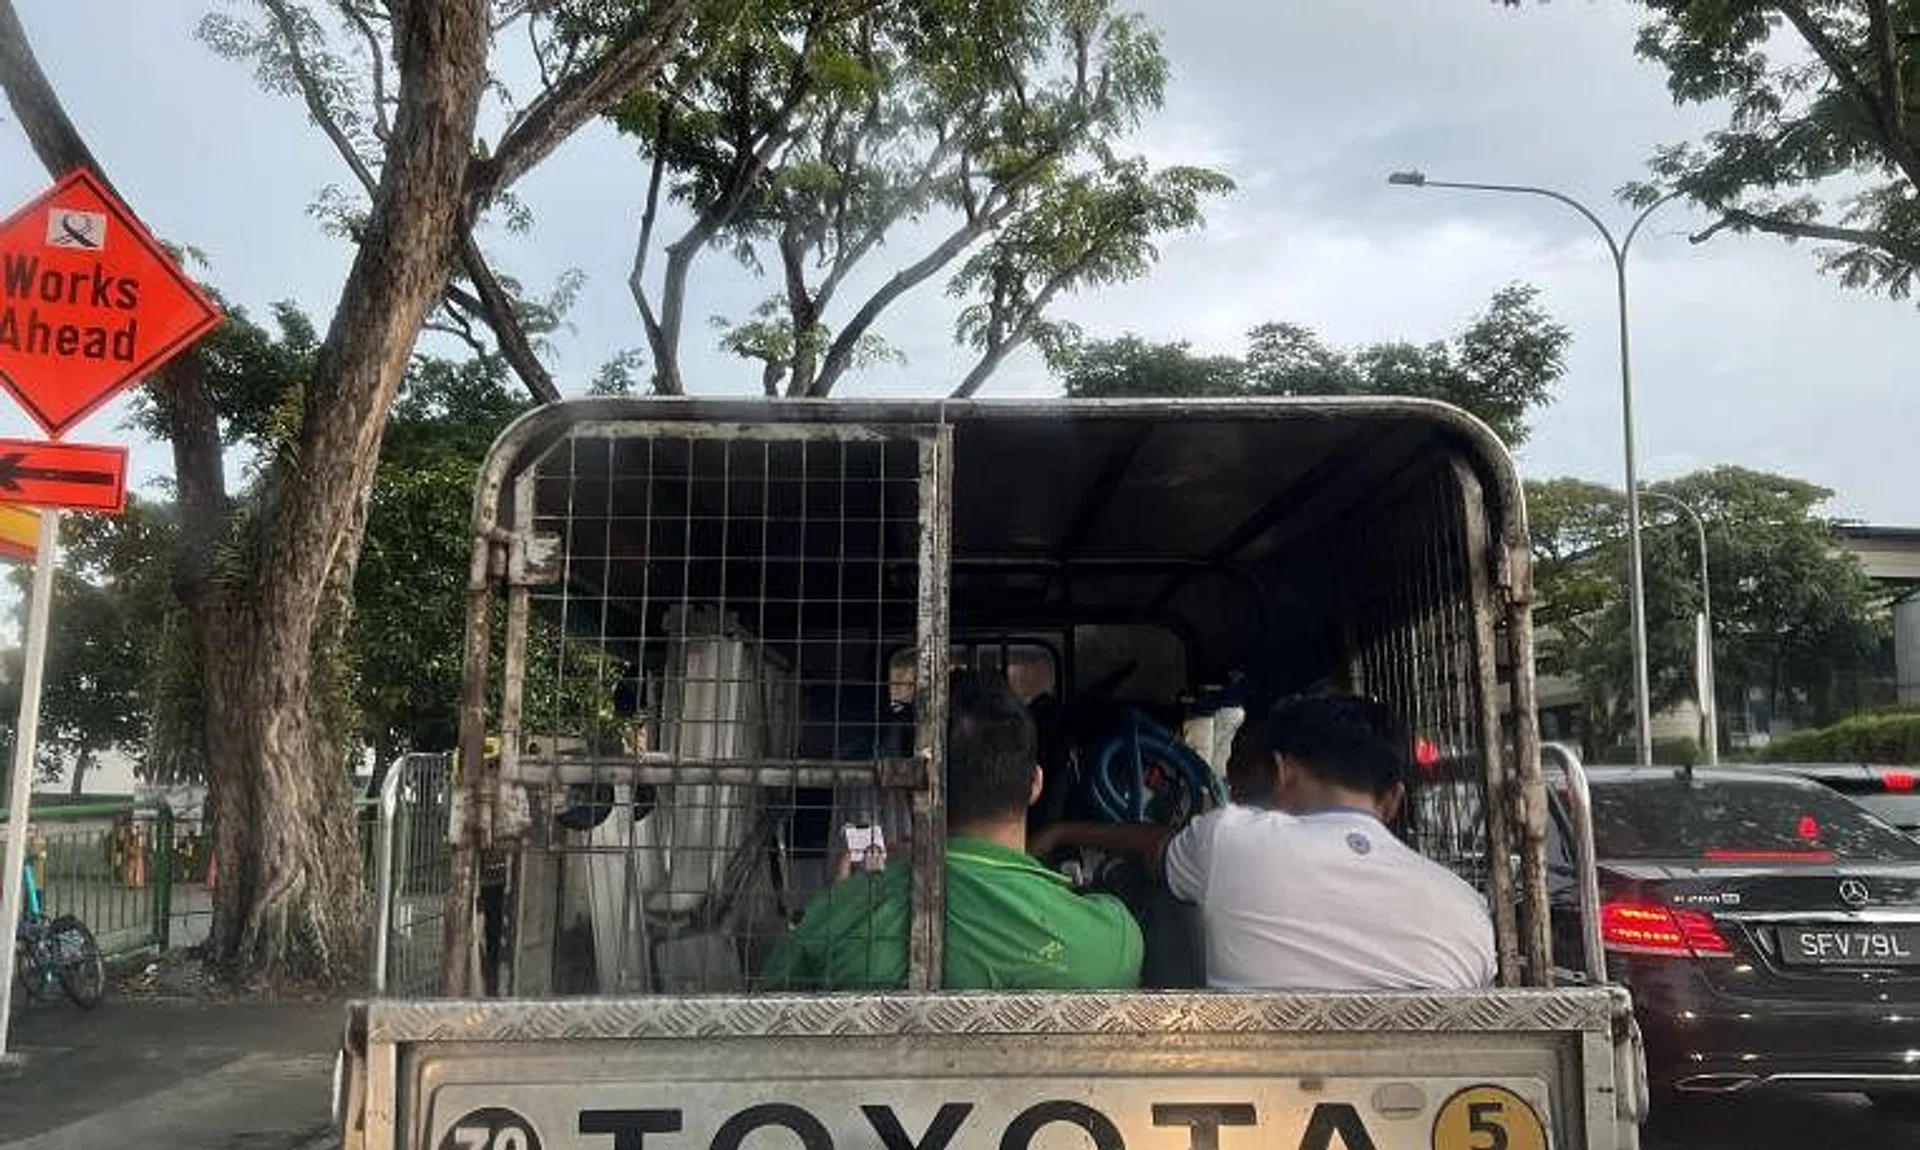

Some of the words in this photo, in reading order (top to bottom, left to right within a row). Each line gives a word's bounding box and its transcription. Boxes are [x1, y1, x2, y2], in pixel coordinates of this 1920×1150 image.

[4, 252, 140, 310] Works
[0, 306, 138, 362] Ahead
[1800, 933, 1850, 956] SFV
[1855, 933, 1911, 956] 79L
[1468, 1102, 1508, 1150] 5
